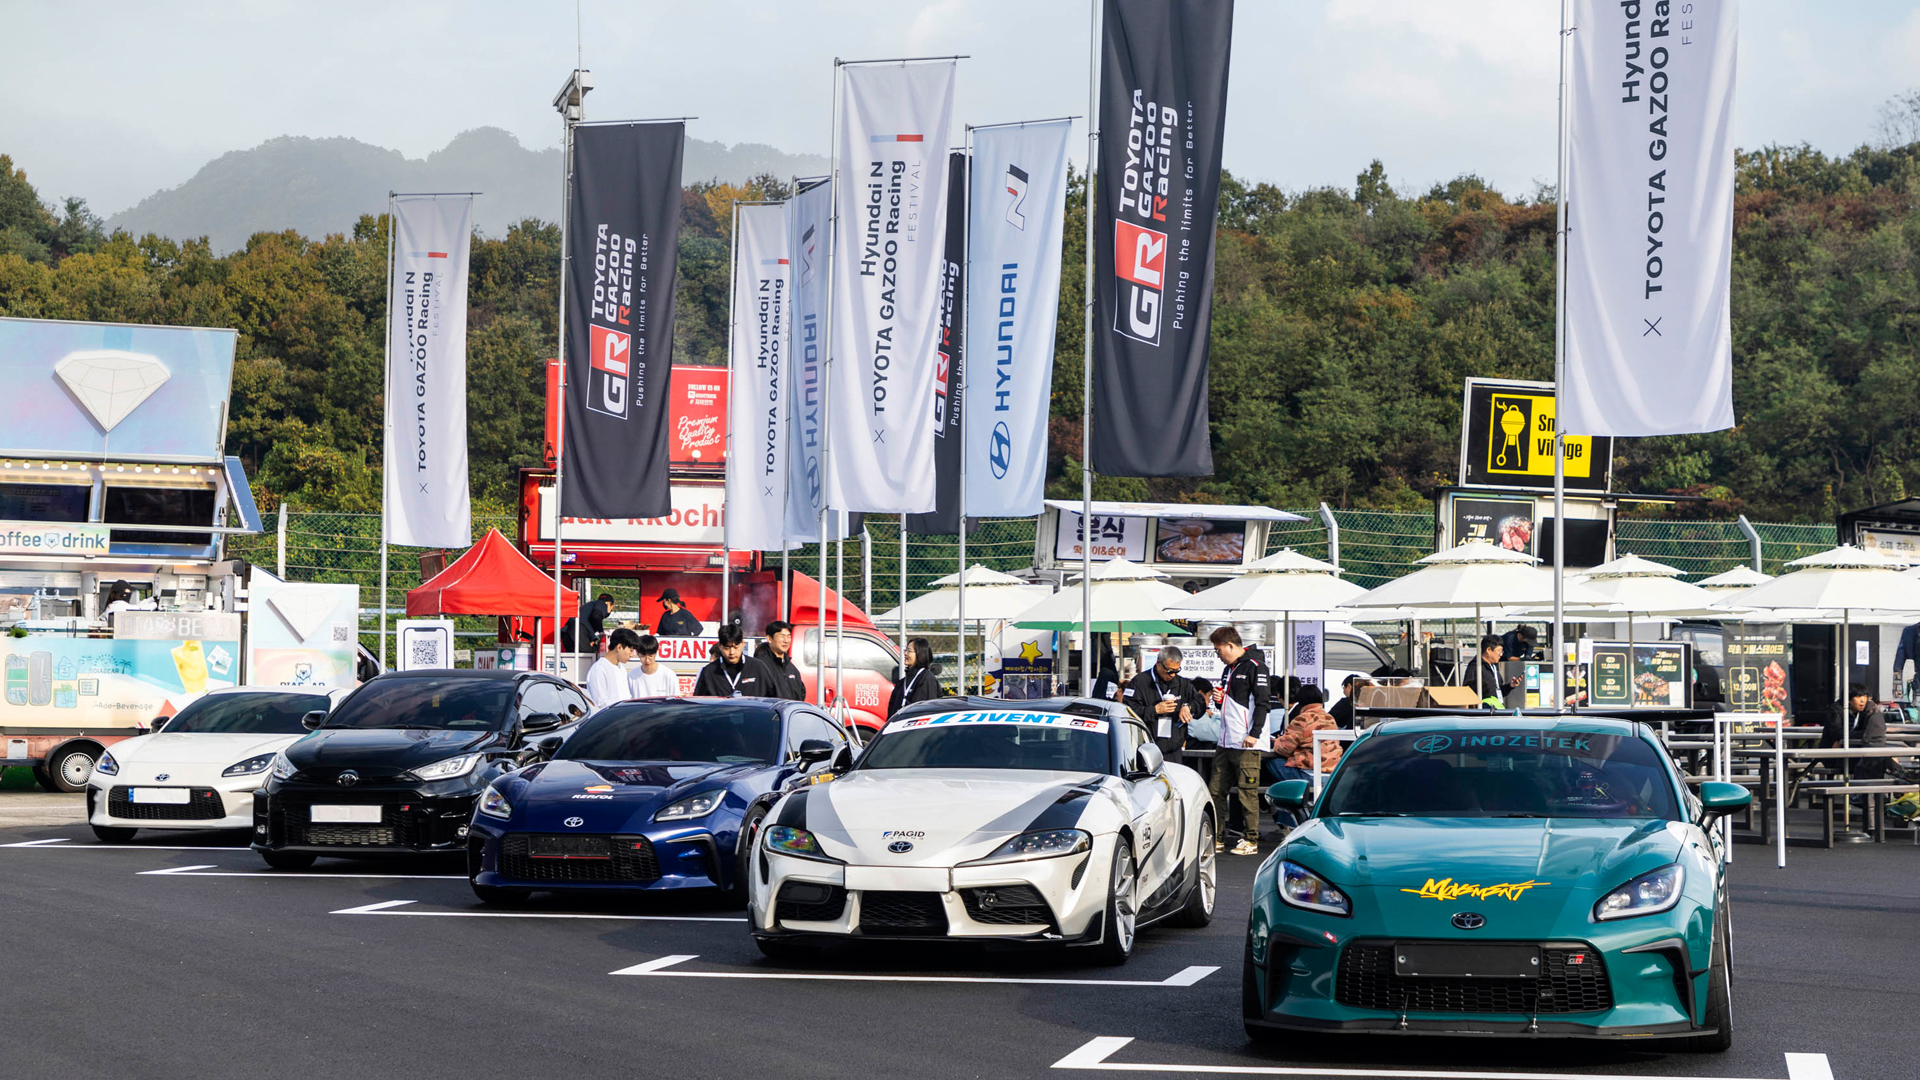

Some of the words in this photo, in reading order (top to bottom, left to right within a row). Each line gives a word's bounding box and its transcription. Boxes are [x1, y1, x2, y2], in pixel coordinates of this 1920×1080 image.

[1649, 46, 1669, 161] GAZOO
[870, 161, 883, 177] N
[1119, 88, 1143, 213] TOYOTA
[1137, 101, 1157, 218] GAZOO
[1153, 106, 1178, 222] Racing
[1185, 158, 1194, 180] for
[886, 161, 906, 234] Racing
[907, 160, 921, 241] FESTIVAL
[1181, 188, 1193, 231] limits
[640, 233, 649, 270] Better
[860, 184, 883, 276] Hyundai
[1179, 239, 1189, 262] the
[1645, 169, 1667, 299] TOYOTA
[405, 271, 415, 285] N
[418, 272, 433, 329] Racing
[592, 224, 608, 318] TOYOTA
[605, 234, 621, 322] GAZOO
[618, 238, 636, 325] Racing
[760, 279, 769, 292] N
[880, 240, 898, 320] GAZOO
[1130, 232, 1164, 339] GR
[1173, 272, 1189, 329] Pushing
[432, 272, 443, 336] FESTIVAL
[757, 297, 770, 368] Hyundai
[772, 278, 784, 335] Racing
[416, 334, 427, 398] GAZOO
[994, 263, 1018, 411] HYUNDAI
[603, 332, 628, 414] GR
[636, 362, 646, 406] Pushing
[769, 340, 778, 402] GAZOO
[873, 326, 893, 416] TOYOTA
[418, 402, 426, 473] TOYOTA
[678, 415, 718, 429] Premium
[679, 425, 715, 440] Quality
[681, 434, 720, 450] Product
[766, 407, 777, 476] TOYOTA
[1537, 438, 1582, 460] Vilge
[62, 533, 105, 548] drink
[1073, 545, 1126, 556] 떡이&순대
[1076, 516, 1125, 543] 분식
[855, 697, 879, 706] FOOD
[958, 713, 1061, 724] ZIVENT
[1071, 718, 1098, 729] GR
[1460, 735, 1591, 750] INOZETEK
